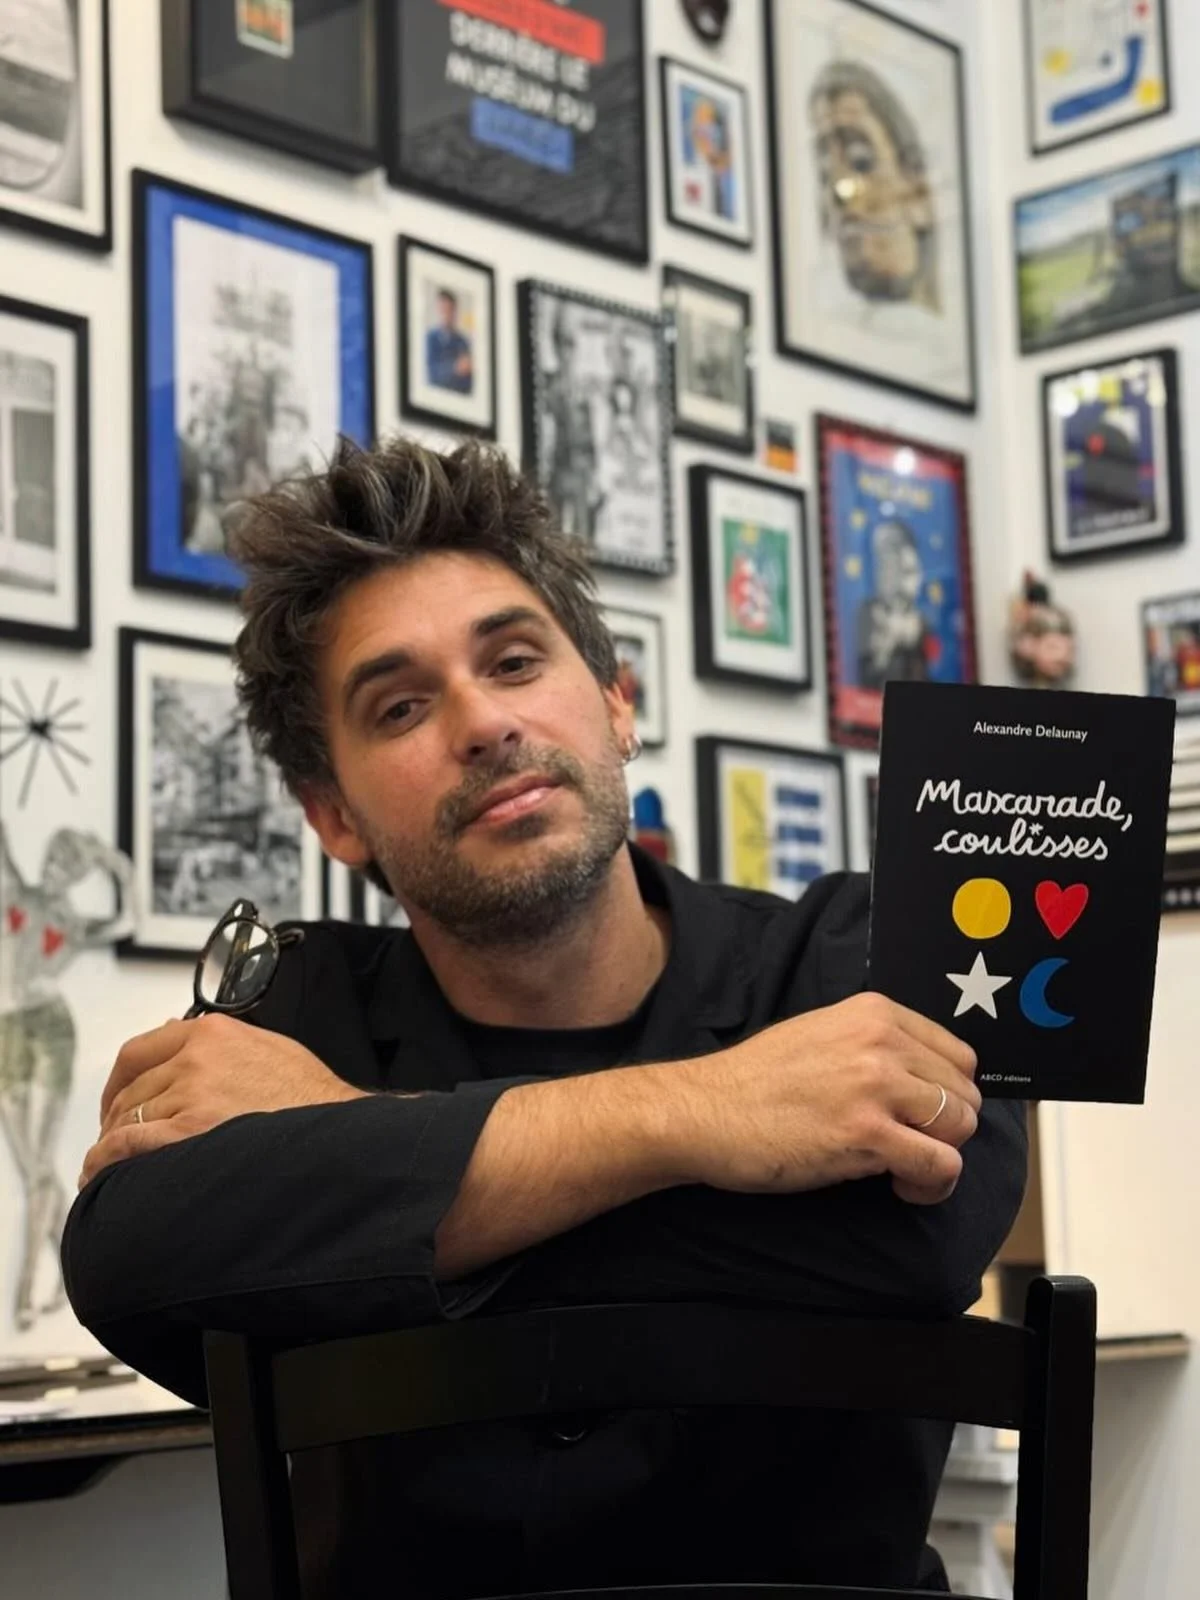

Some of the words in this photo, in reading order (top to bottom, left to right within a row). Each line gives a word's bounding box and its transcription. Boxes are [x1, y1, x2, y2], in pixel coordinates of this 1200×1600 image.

[973, 721, 1032, 737] Alexandre
[1035, 724, 1088, 743] Delaunay
[915, 779, 1133, 832] Mascarade,
[933, 817, 1109, 861] coulisses
